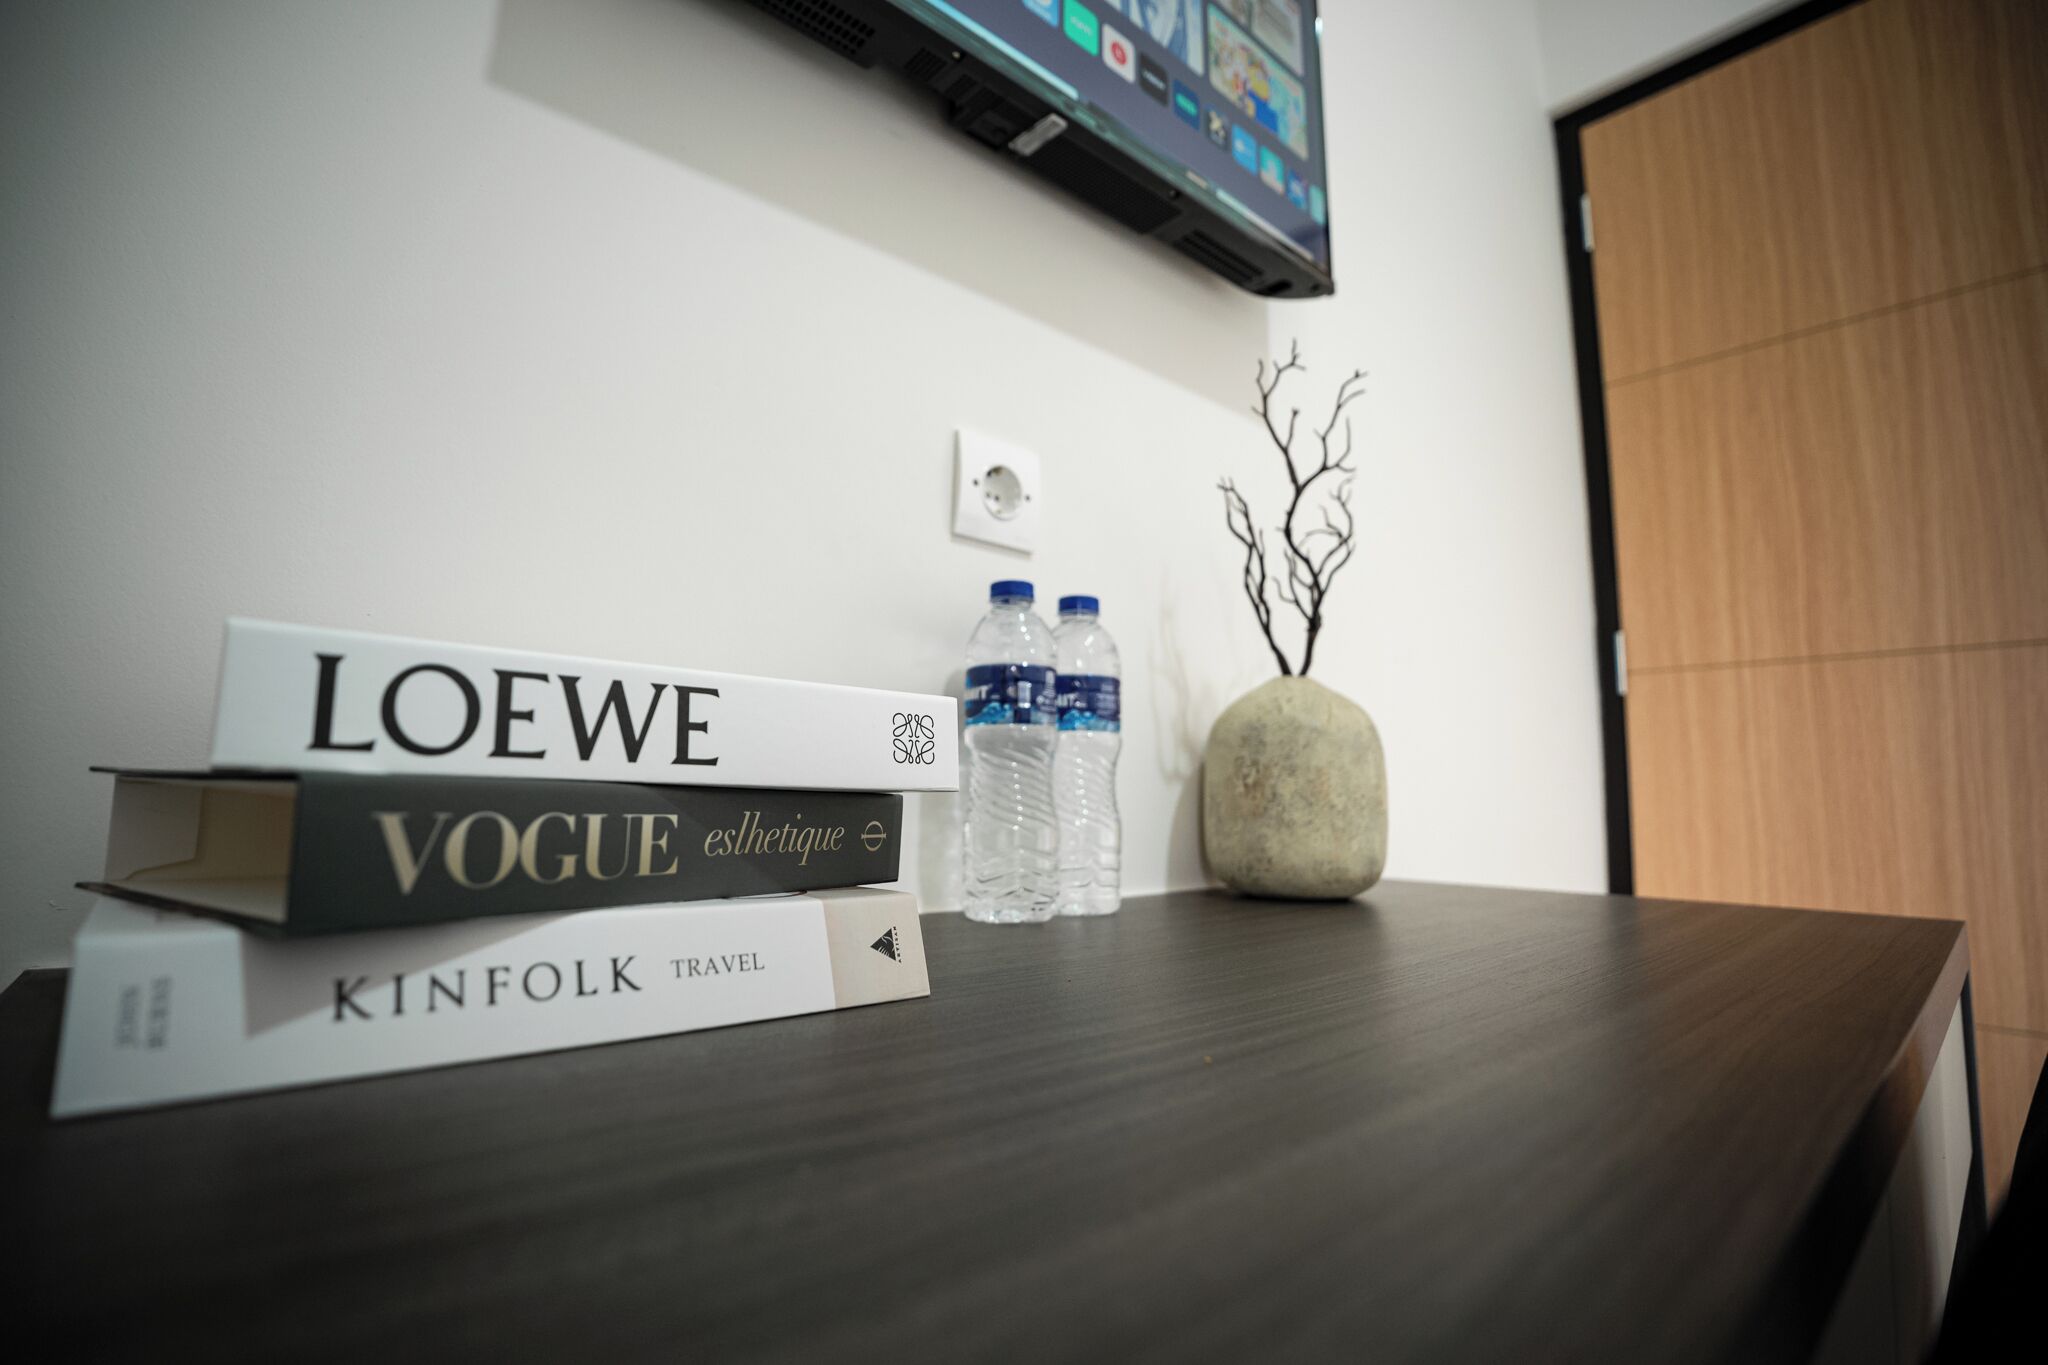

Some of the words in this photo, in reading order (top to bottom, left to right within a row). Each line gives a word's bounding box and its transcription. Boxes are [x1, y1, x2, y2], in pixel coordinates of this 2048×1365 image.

[308, 652, 721, 767] LOEWE
[372, 810, 680, 894] VOGUE
[332, 956, 643, 1022] KINFOLK
[669, 952, 766, 979] TRAVEL
